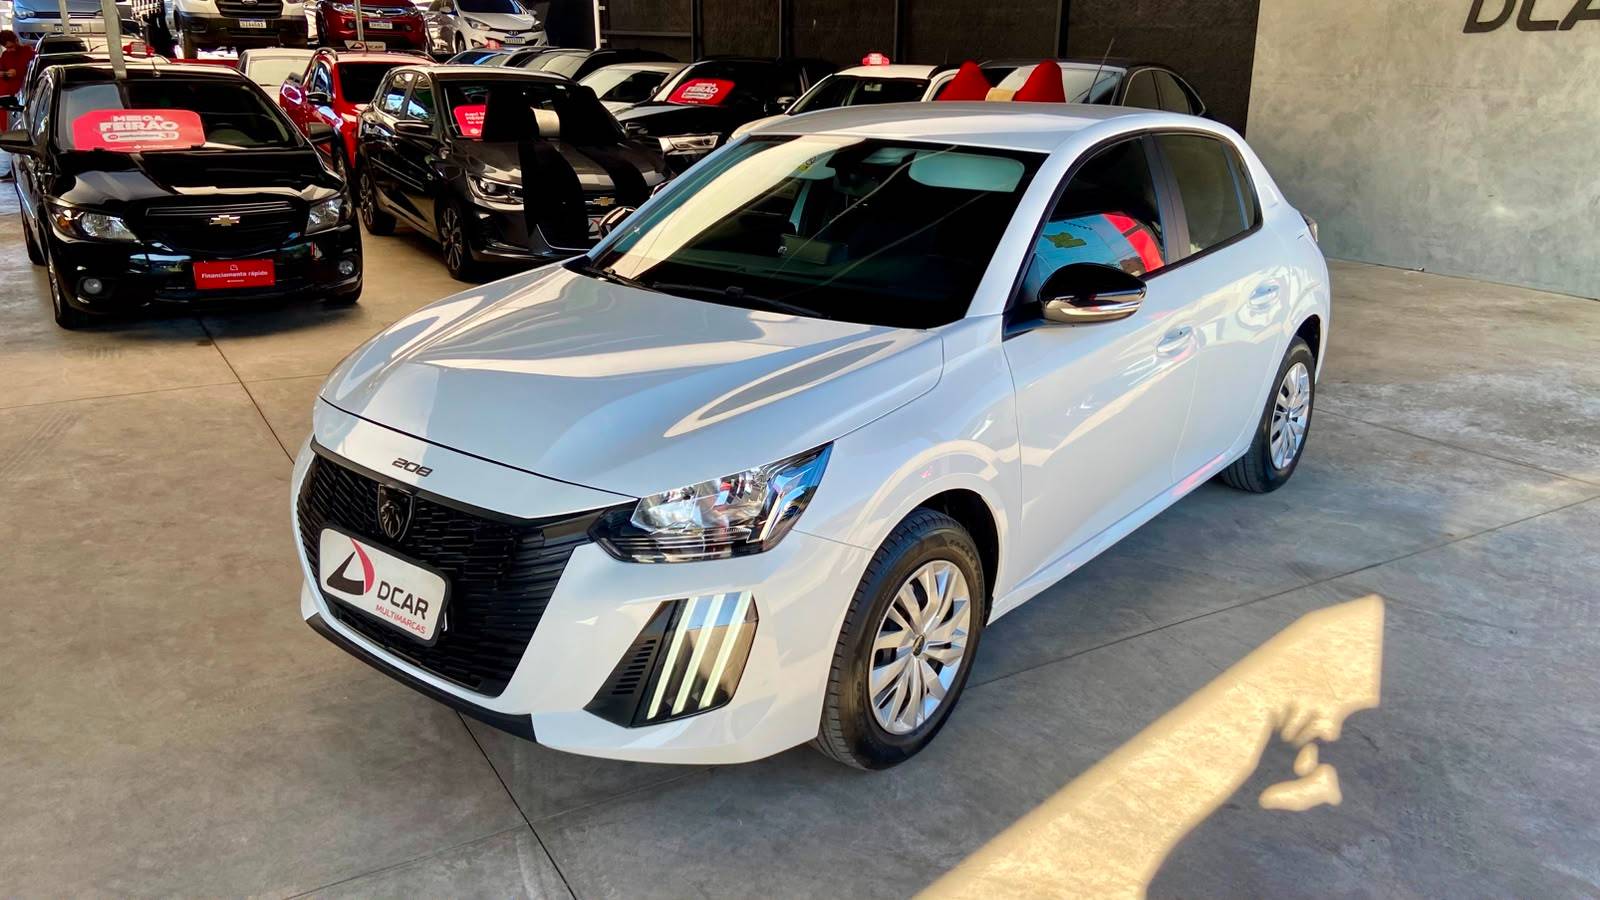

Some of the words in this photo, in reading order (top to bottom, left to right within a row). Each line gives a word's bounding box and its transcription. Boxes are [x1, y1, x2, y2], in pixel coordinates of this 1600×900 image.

[99, 120, 179, 132] FEIRÃO
[391, 458, 432, 477] 208
[377, 580, 429, 620] DCAR
[375, 604, 427, 635] MULTIMARCAS
